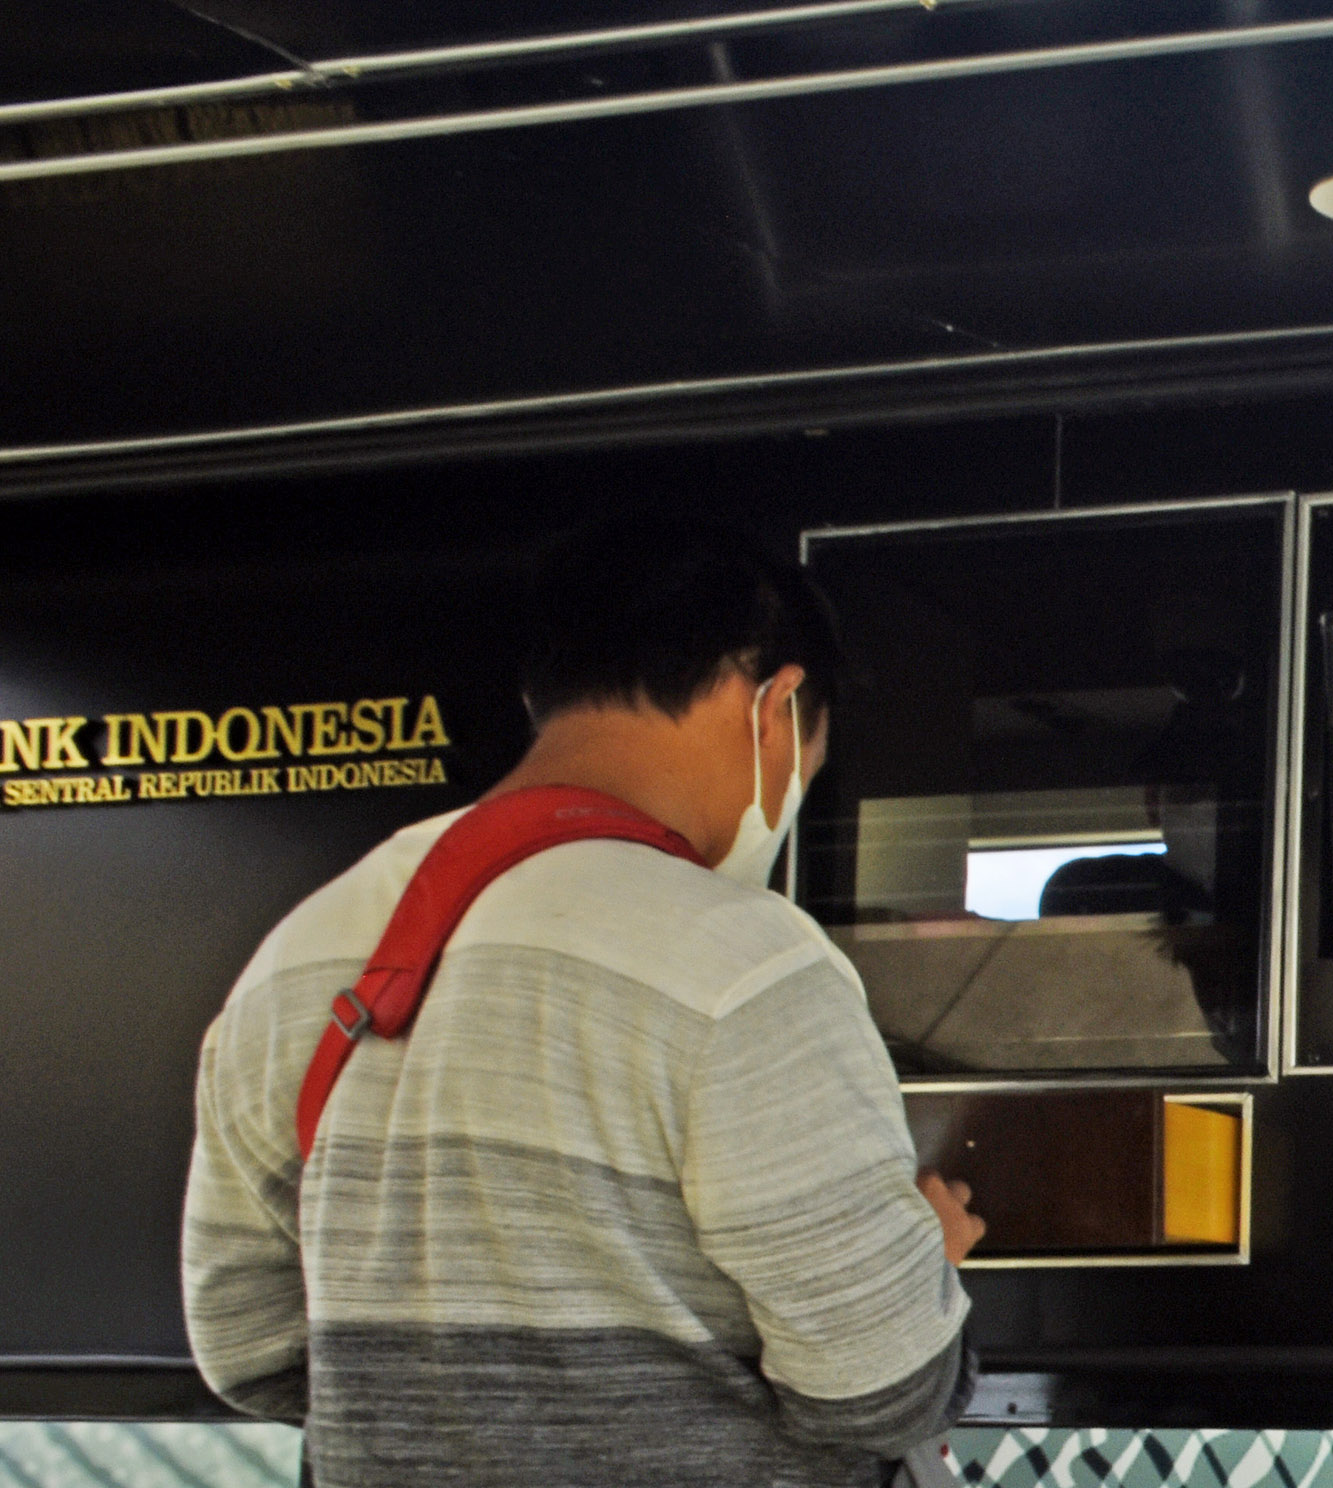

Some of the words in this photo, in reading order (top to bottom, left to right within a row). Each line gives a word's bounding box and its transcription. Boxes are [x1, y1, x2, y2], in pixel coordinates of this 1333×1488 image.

[101, 695, 450, 766] INDONESIA
[4, 776, 131, 806] SENTRAL
[139, 769, 282, 798] REPUBLIK
[288, 759, 446, 792] INDONESIA
